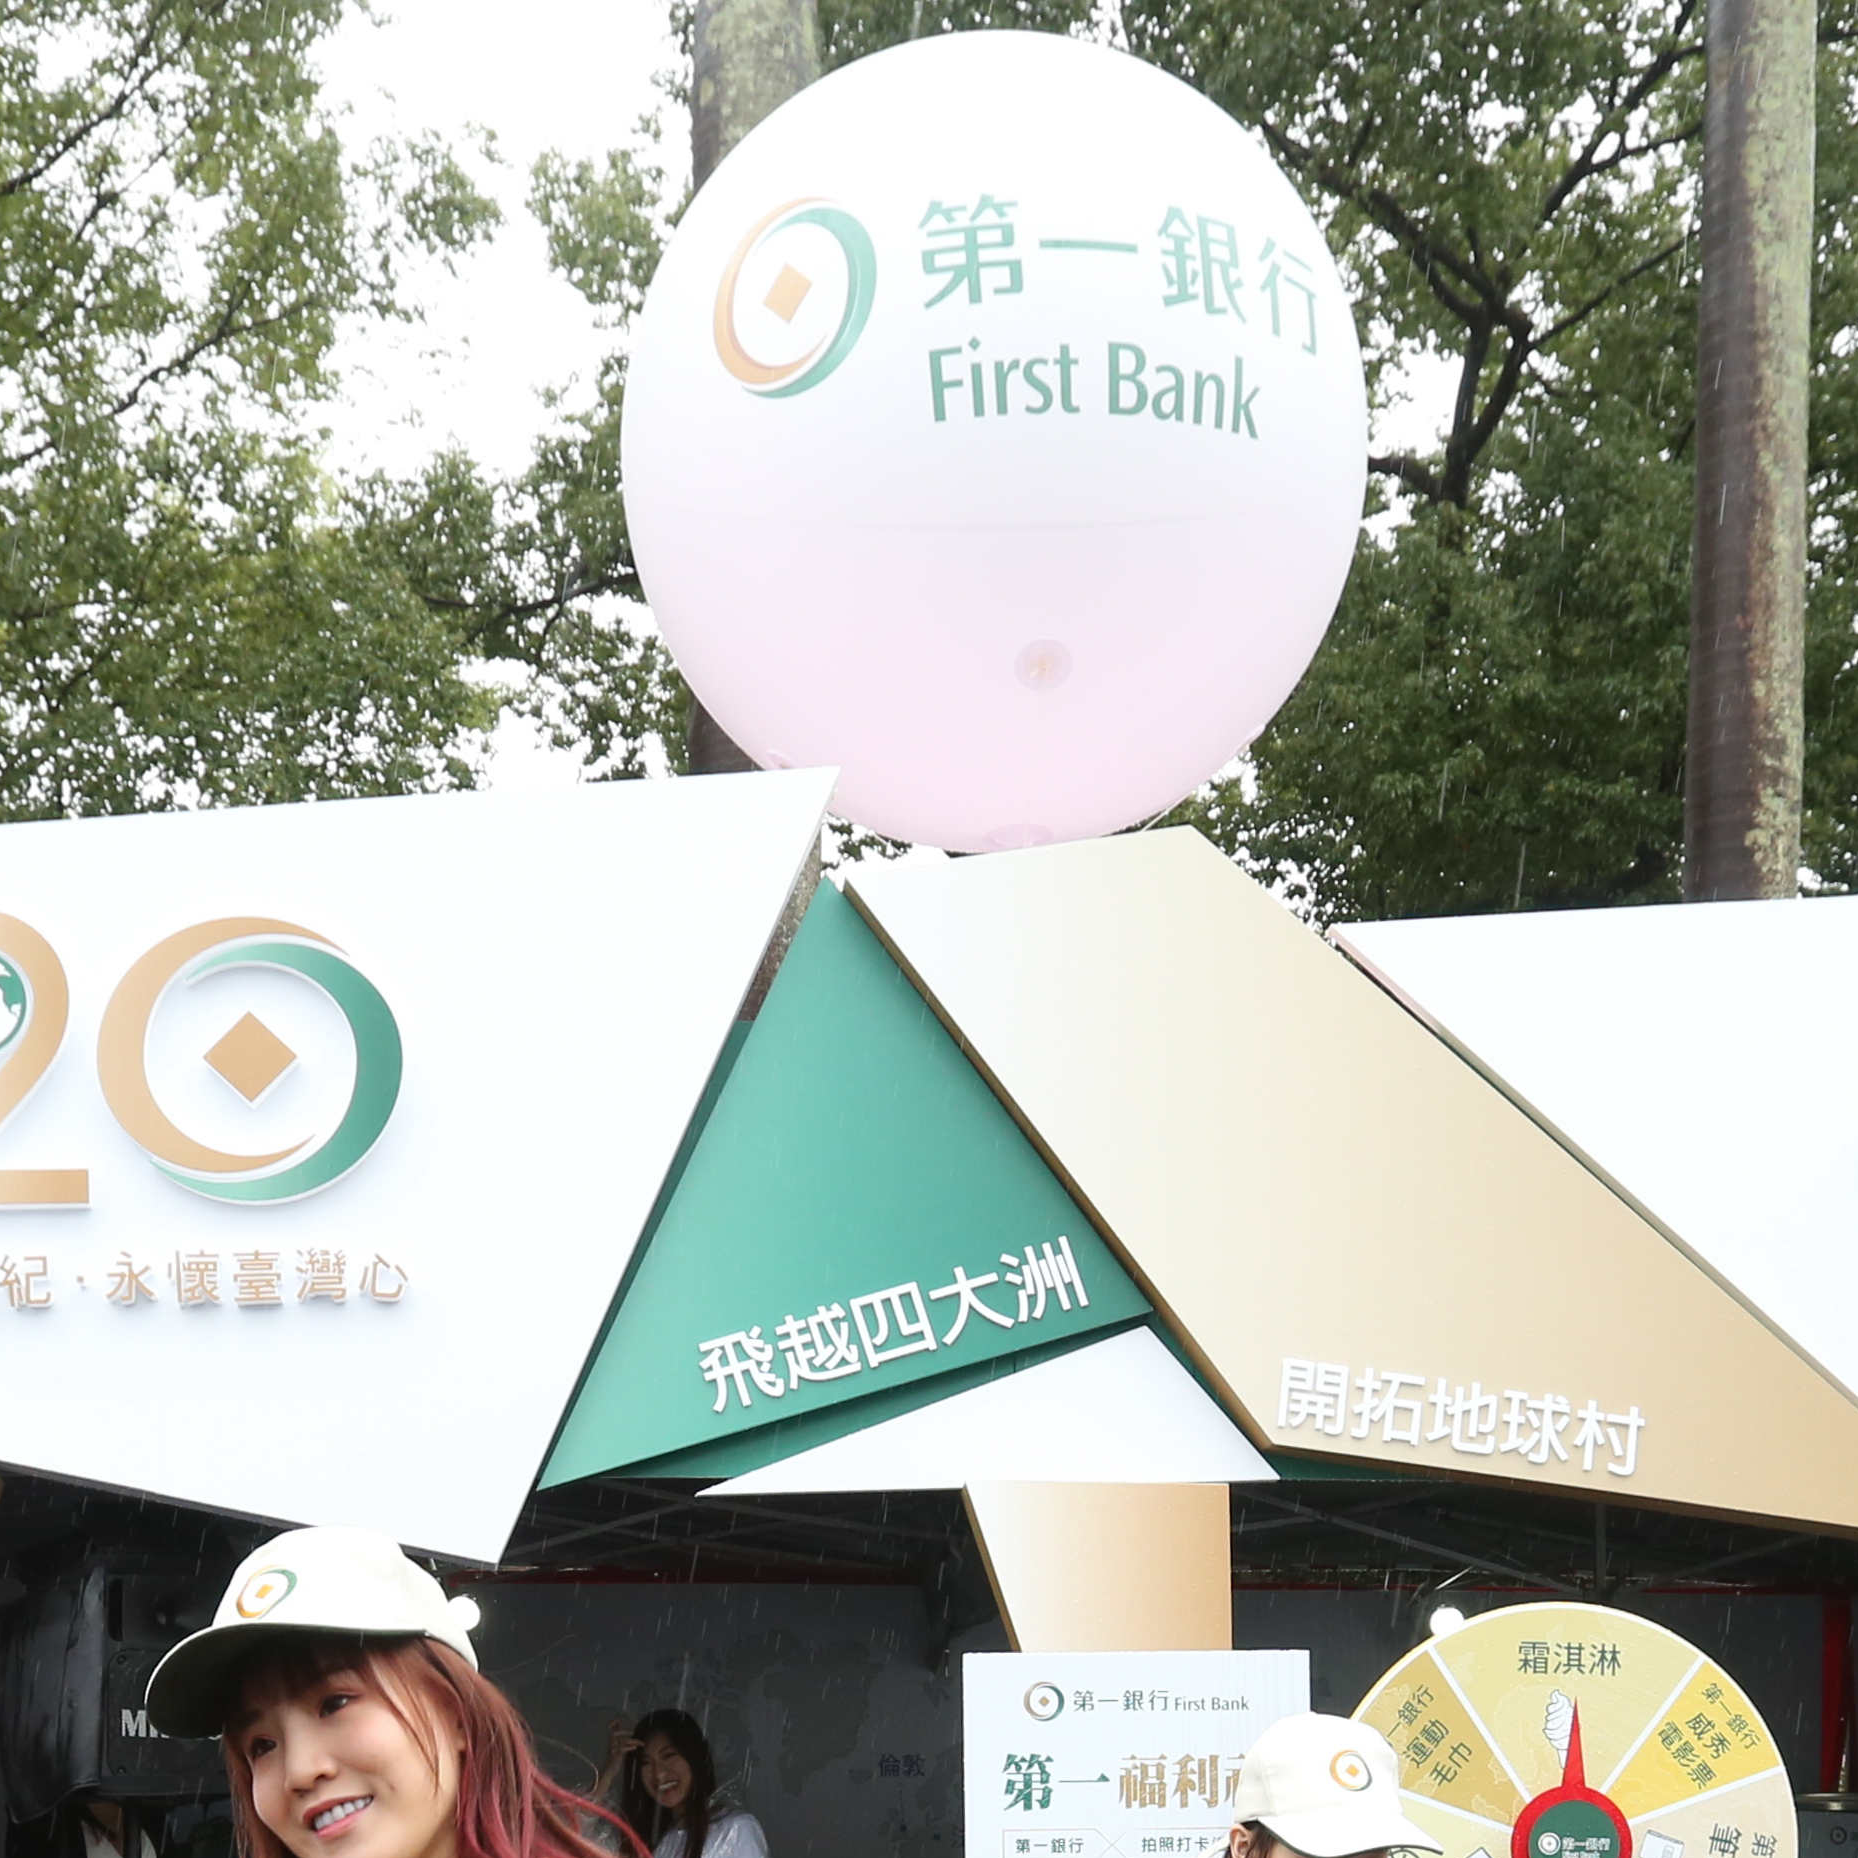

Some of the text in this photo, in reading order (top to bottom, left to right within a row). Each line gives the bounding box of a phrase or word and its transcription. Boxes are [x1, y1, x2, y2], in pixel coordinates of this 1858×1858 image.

[916, 193, 1318, 356] 第一銀行
[928, 336, 1261, 440] First Bank
[695, 1235, 1091, 1415] 飛越四大洲
[1274, 1355, 1647, 1478] 開拓地球村
[1516, 1640, 1623, 1678] 霜淇淋
[1072, 1688, 1251, 1713] 第一銀行 First Bank
[1387, 1683, 1435, 1748] 一銀行
[1701, 1682, 1762, 1750] 第一銀行
[1402, 1719, 1450, 1769] 運動
[1656, 1720, 1718, 1791] 電影票
[1685, 1711, 1732, 1760] 威秀
[877, 1752, 927, 1779] 倫敦
[1428, 1741, 1473, 1788] 毛巾
[1014, 1837, 1085, 1855] 第一銀行
[1141, 1836, 1223, 1854] 拍照打卡
